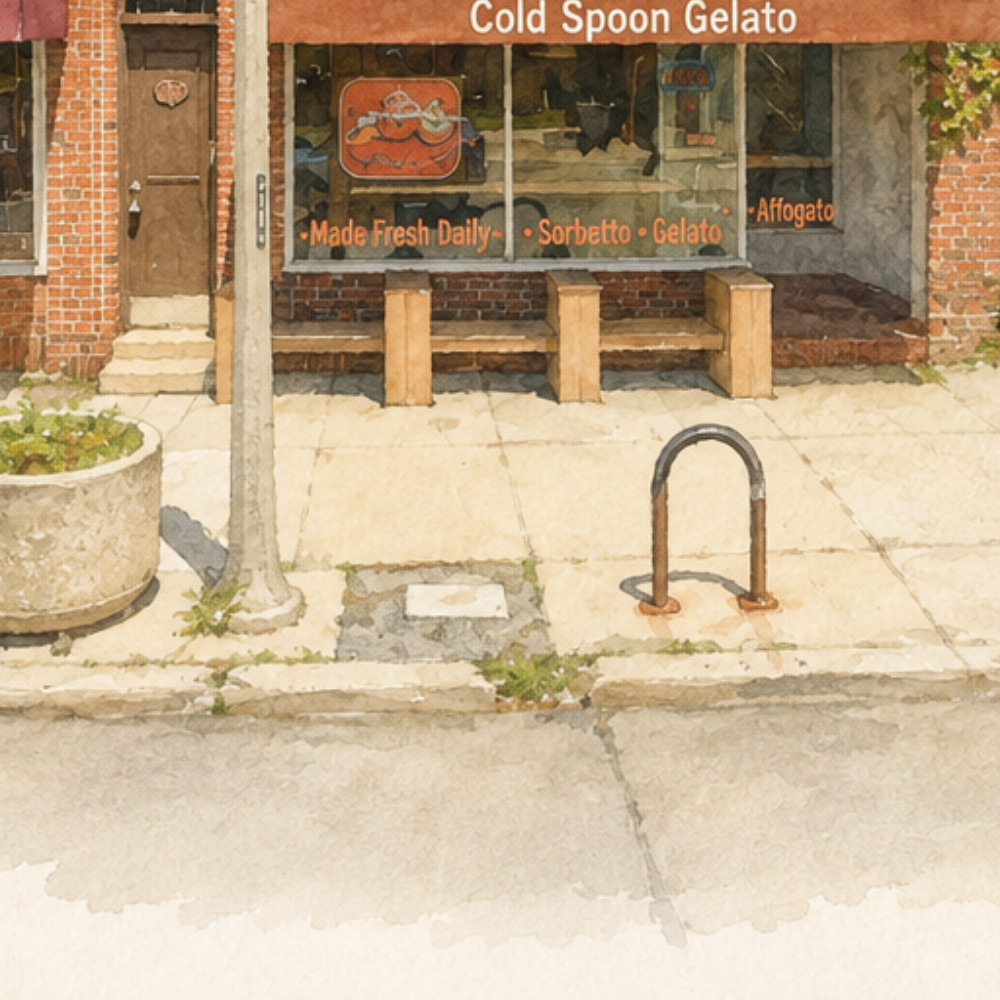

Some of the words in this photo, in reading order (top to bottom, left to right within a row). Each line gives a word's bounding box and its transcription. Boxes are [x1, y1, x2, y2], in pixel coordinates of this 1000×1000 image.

[757, 197, 835, 229] Affogato
[310, 218, 367, 247] Made
[371, 217, 430, 247] Fresh
[438, 217, 491, 254] Daily
[538, 217, 631, 246] Sorbetto
[653, 216, 722, 246] Gelato
